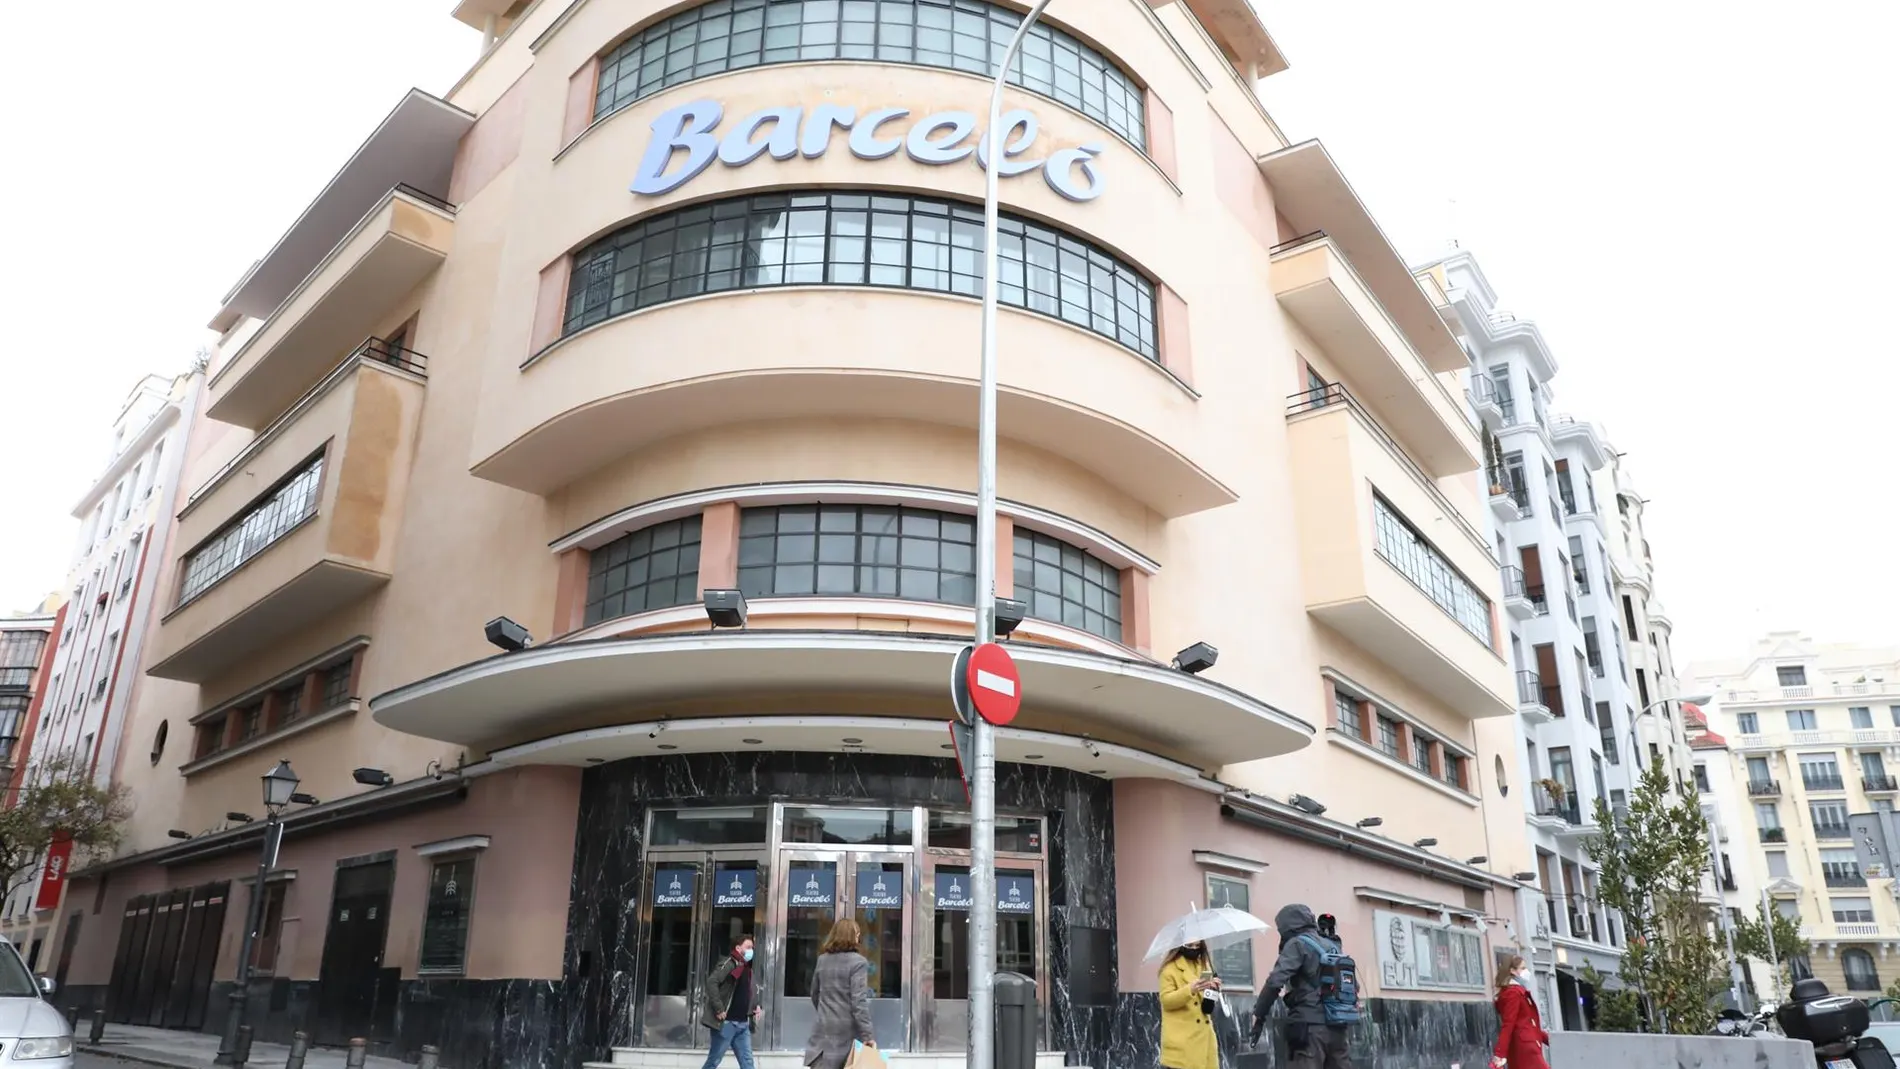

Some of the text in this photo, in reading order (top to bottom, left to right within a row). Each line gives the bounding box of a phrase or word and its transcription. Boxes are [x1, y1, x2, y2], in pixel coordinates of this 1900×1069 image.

[631, 98, 1103, 203] Barceló
[658, 895, 691, 903] Barceló
[717, 895, 752, 904] Barceló
[792, 895, 831, 903] Barceló
[860, 896, 898, 905] Barceló
[998, 900, 1030, 910] Barceló
